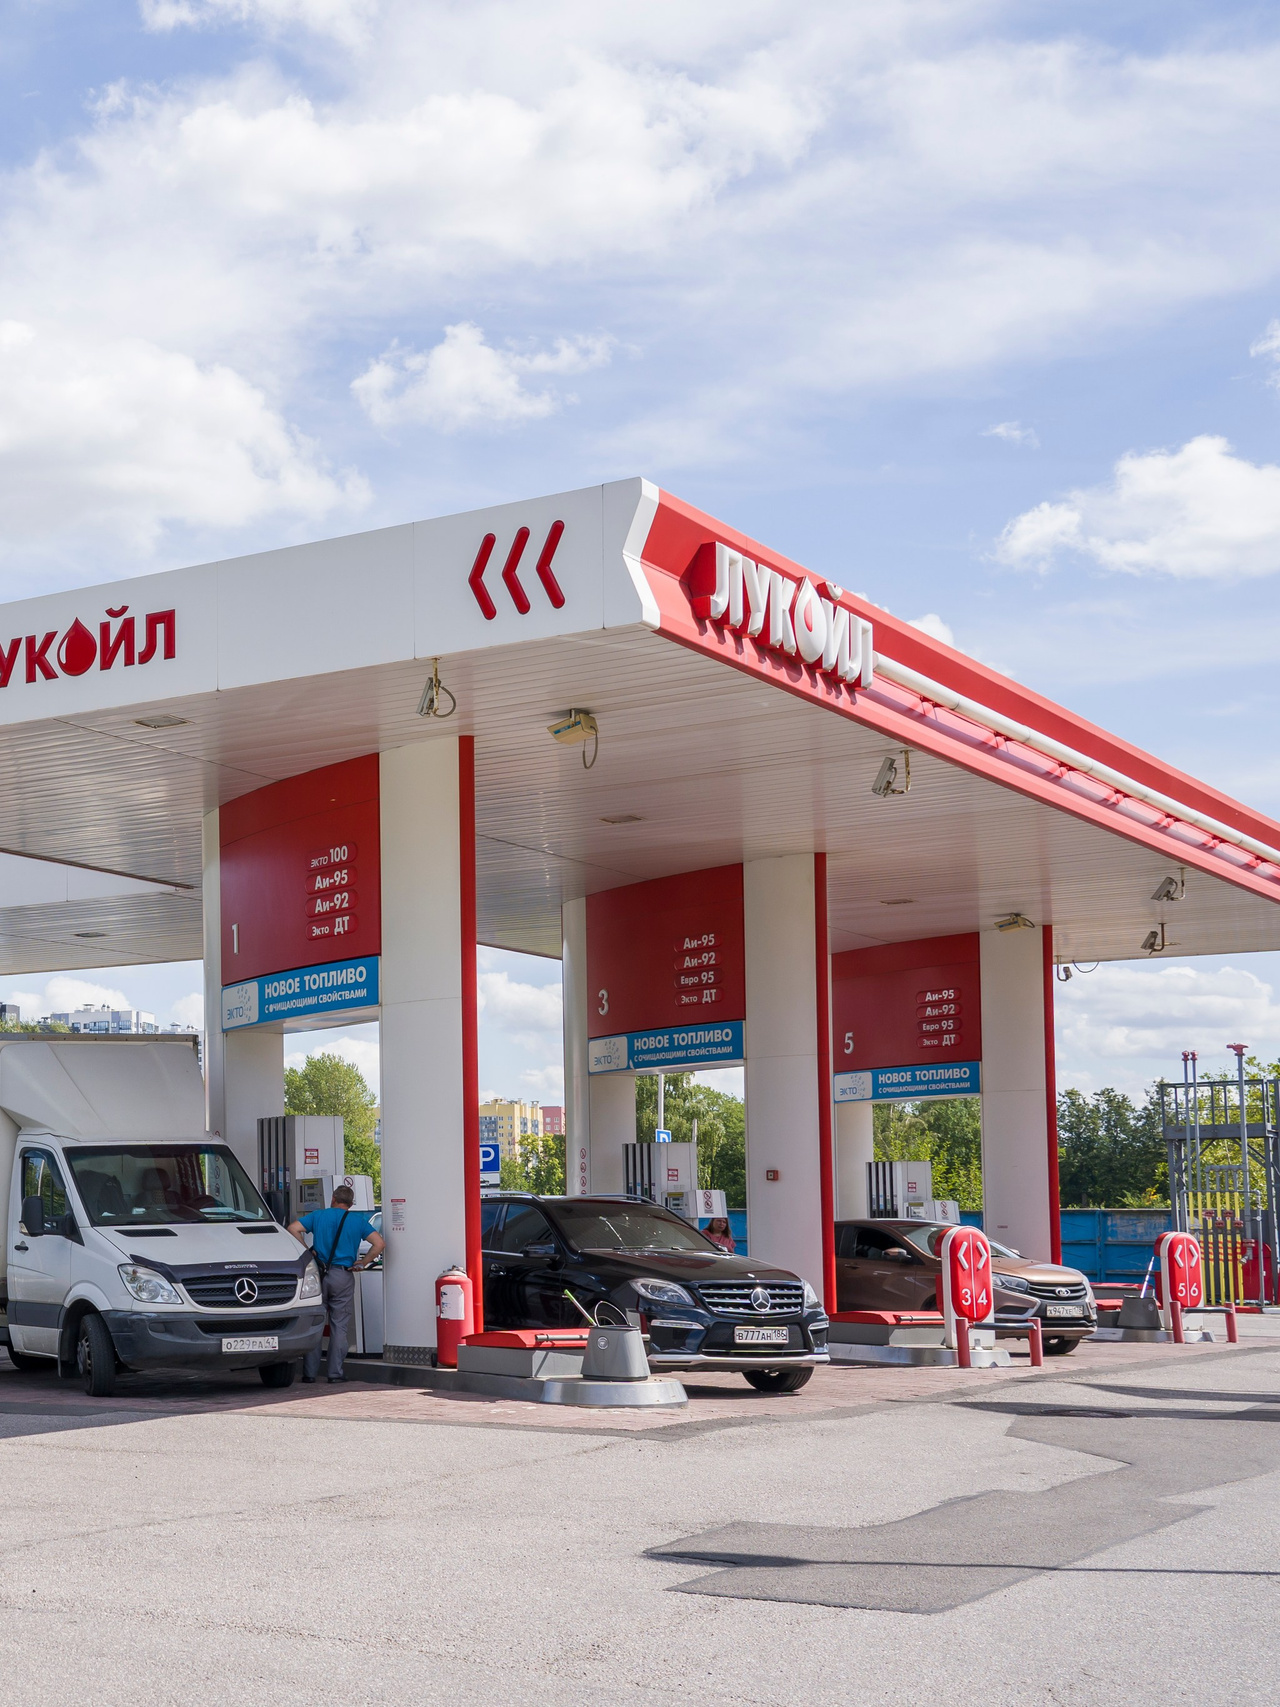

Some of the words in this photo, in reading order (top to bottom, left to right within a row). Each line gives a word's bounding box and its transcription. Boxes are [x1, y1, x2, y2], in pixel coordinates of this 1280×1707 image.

[700, 540, 873, 690] ЛУКОЙЛ
[329, 845, 348, 863] 100
[314, 869, 348, 891] Аи-95
[314, 892, 349, 914] Аи-92
[311, 925, 329, 937] Экто
[333, 916, 350, 935] ДТ
[231, 923, 239, 955] 1
[683, 934, 715, 949] Аи-95
[683, 952, 716, 968] Аи-92
[264, 977, 300, 999] НОВОЕ
[303, 966, 367, 990] ТОПЛИВО
[680, 975, 698, 985] Евро
[700, 971, 715, 984] 95
[269, 996, 318, 1013] ОЧИЩАЮЩИМИ
[318, 988, 367, 1004] СВОЙСТВАМИ
[598, 989, 609, 1016] 3
[680, 995, 698, 1004] Экто
[702, 989, 717, 1004] ДТ
[925, 990, 955, 1002] Аи-95
[226, 1005, 244, 1020] ЭКТО
[925, 1004, 955, 1016] Аи-92
[922, 1024, 939, 1032] Евро
[941, 1020, 954, 1030] 95
[634, 1035, 669, 1051] НОВОЕ
[673, 1029, 732, 1046] ТОПЛИВО
[844, 1032, 854, 1054] 5
[942, 1034, 956, 1046] ДТ
[594, 1056, 612, 1066] ЭКТО
[639, 1049, 686, 1062] ОЧИЩАЮЩИМИ
[687, 1046, 733, 1057] СВОЙСТВАМИ
[878, 1071, 912, 1084] НОВОЕ
[915, 1068, 970, 1081] ТОПЛИВО
[839, 1087, 857, 1096] ЭКТО
[882, 1084, 928, 1094] ОЧИЩАЮЩИМИ
[928, 1081, 970, 1091] СВОЙСТВАМИ
[479, 1147, 495, 1170] P
[961, 1288, 971, 1306] 3
[977, 1288, 987, 1306] 4
[1178, 1282, 1186, 1297] 5
[1190, 1282, 1199, 1297] 6
